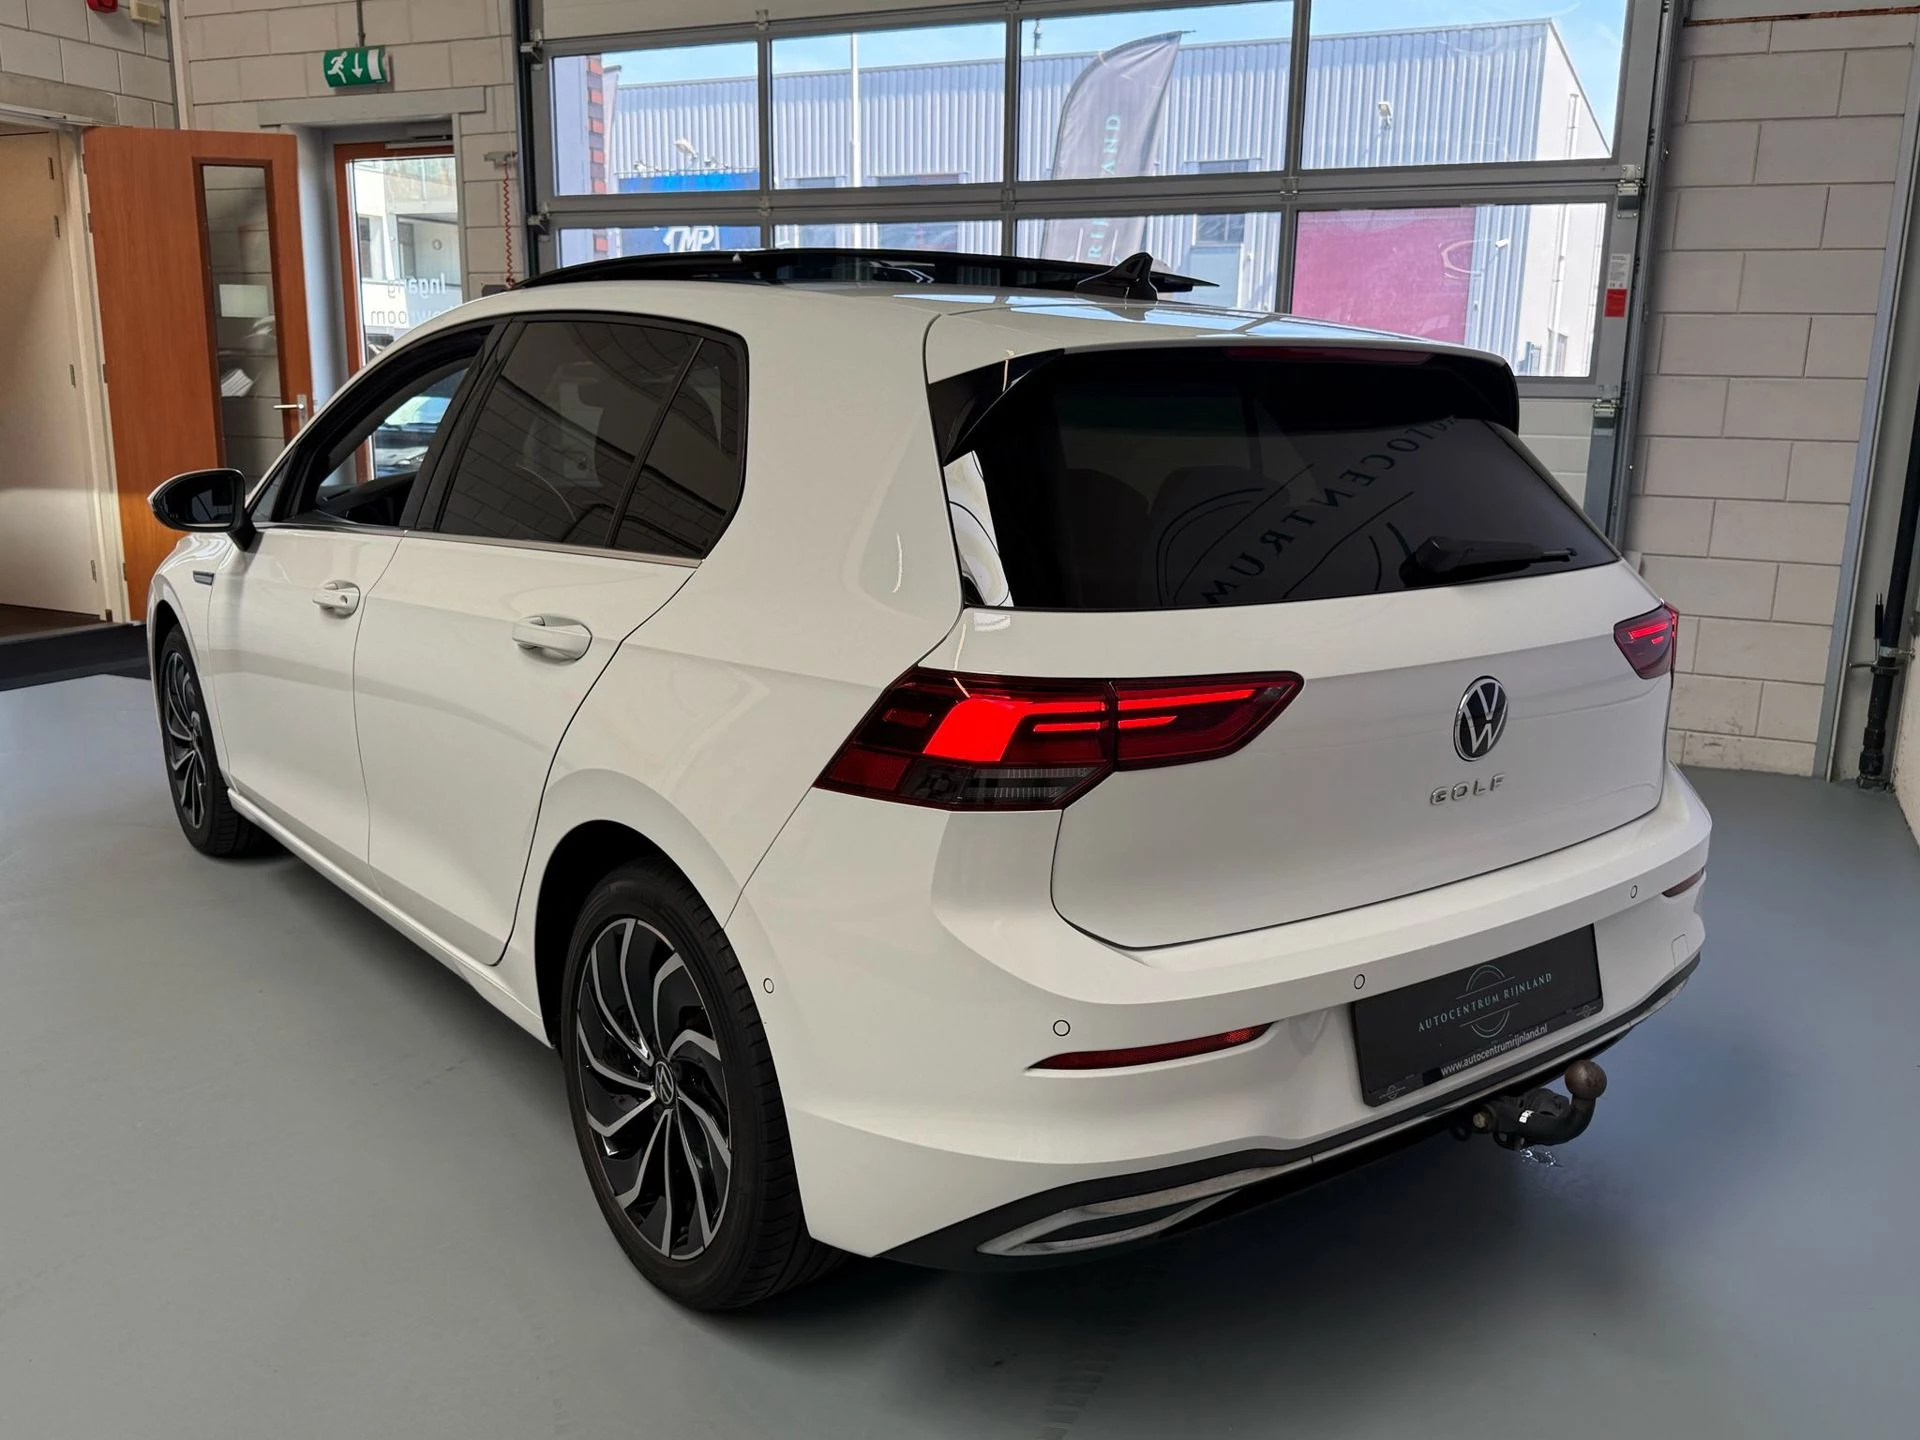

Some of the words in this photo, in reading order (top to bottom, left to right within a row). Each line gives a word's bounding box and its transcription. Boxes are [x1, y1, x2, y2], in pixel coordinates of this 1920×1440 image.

[1087, 113, 1120, 258] RIJAND
[1430, 772, 1506, 806] GOLF
[1418, 993, 1500, 1032] AUTOCENTRUM
[1503, 972, 1553, 999] RIJNLAND
[1440, 1023, 1548, 1076] www.autocentrumrijnland.nl
